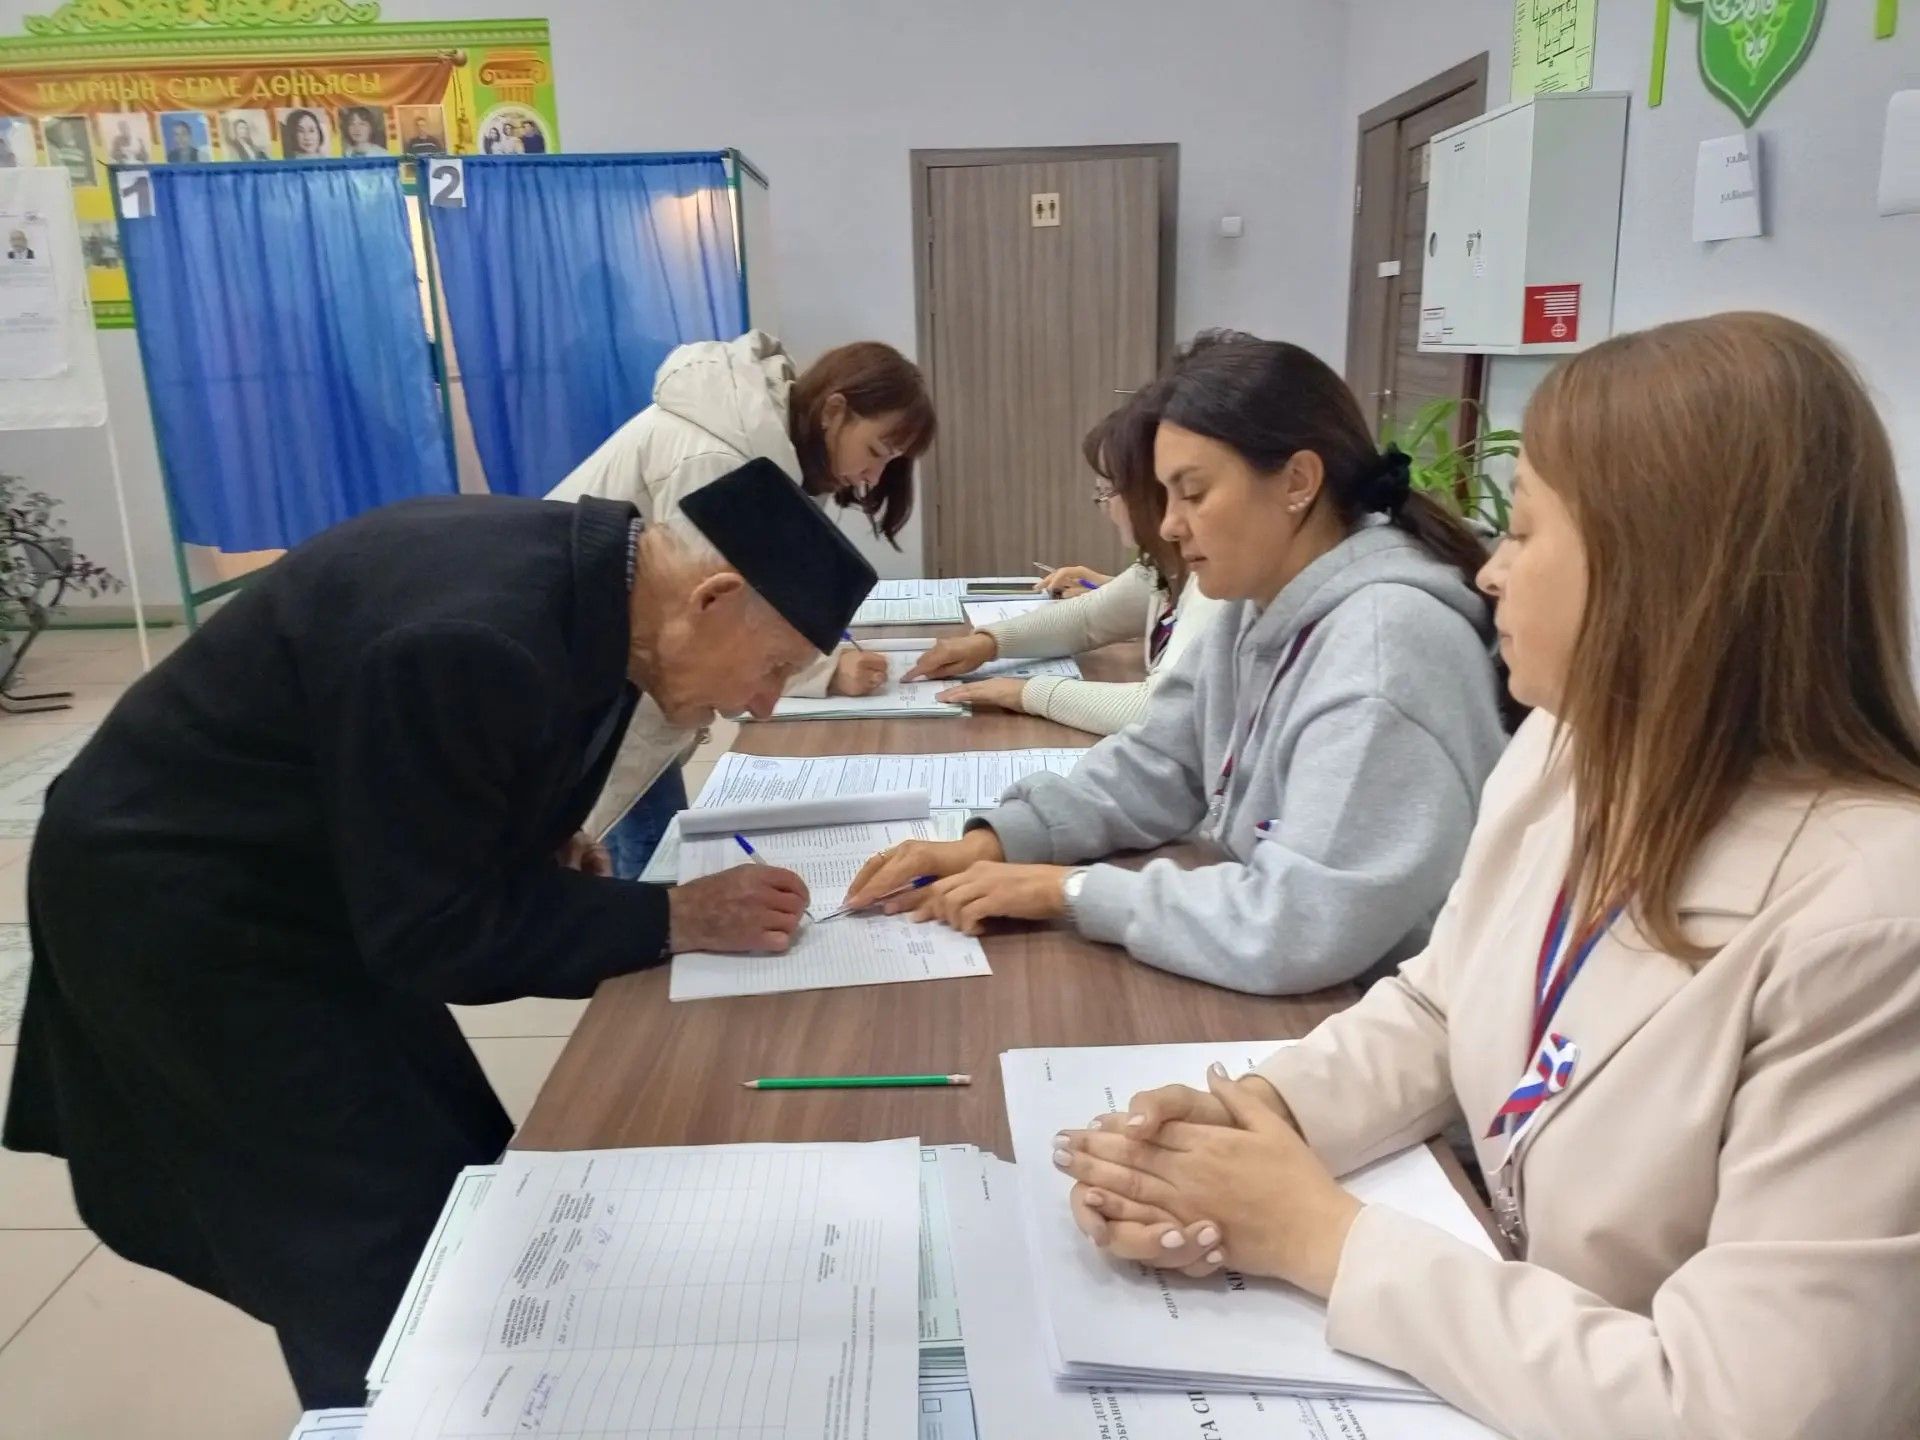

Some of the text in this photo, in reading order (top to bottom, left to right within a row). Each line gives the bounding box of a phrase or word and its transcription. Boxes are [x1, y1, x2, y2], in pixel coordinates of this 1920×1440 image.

[251, 71, 383, 101] ДӨНЬЯСЫ
[122, 176, 152, 218] 1
[432, 165, 464, 208] 2
